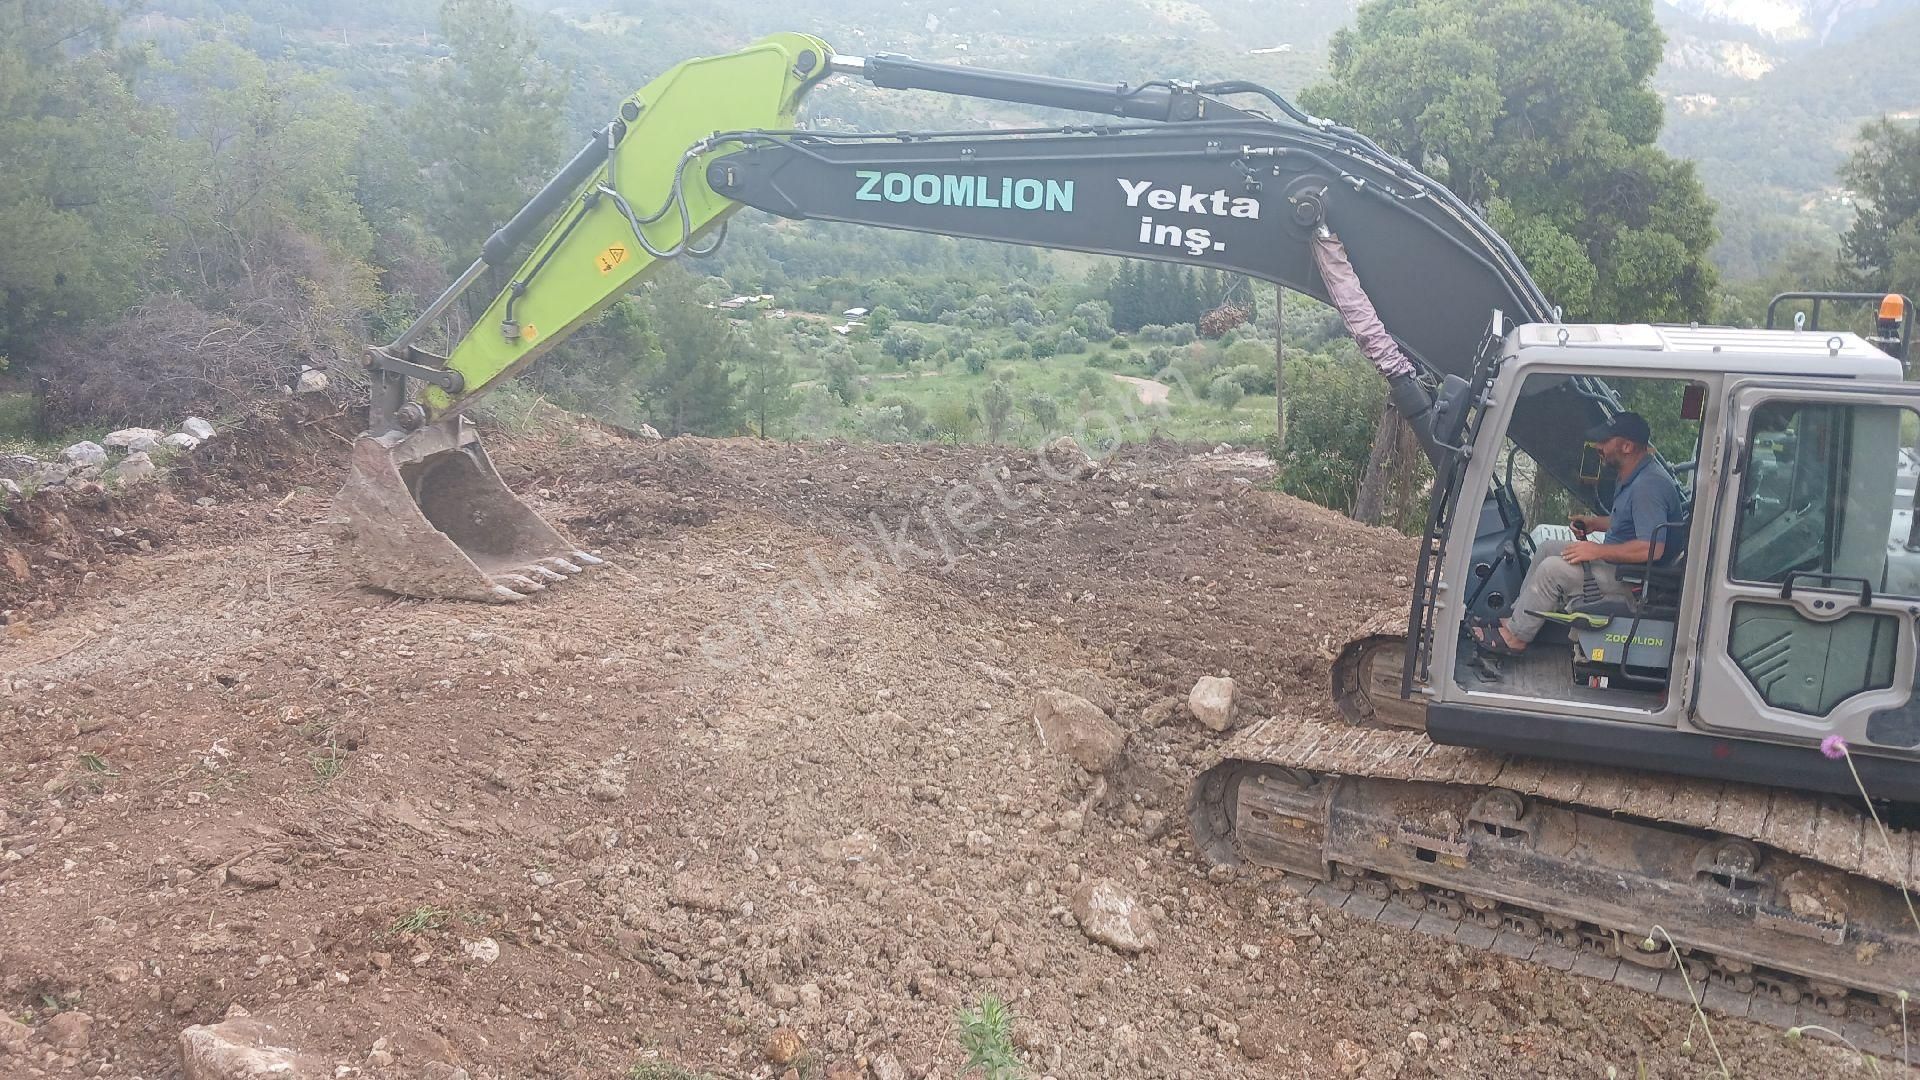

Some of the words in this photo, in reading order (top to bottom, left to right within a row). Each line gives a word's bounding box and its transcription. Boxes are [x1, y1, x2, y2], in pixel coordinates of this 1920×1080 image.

[855, 170, 1075, 212] ZOOMLION
[1116, 178, 1261, 220] Yekta
[1139, 216, 1226, 256] inş.
